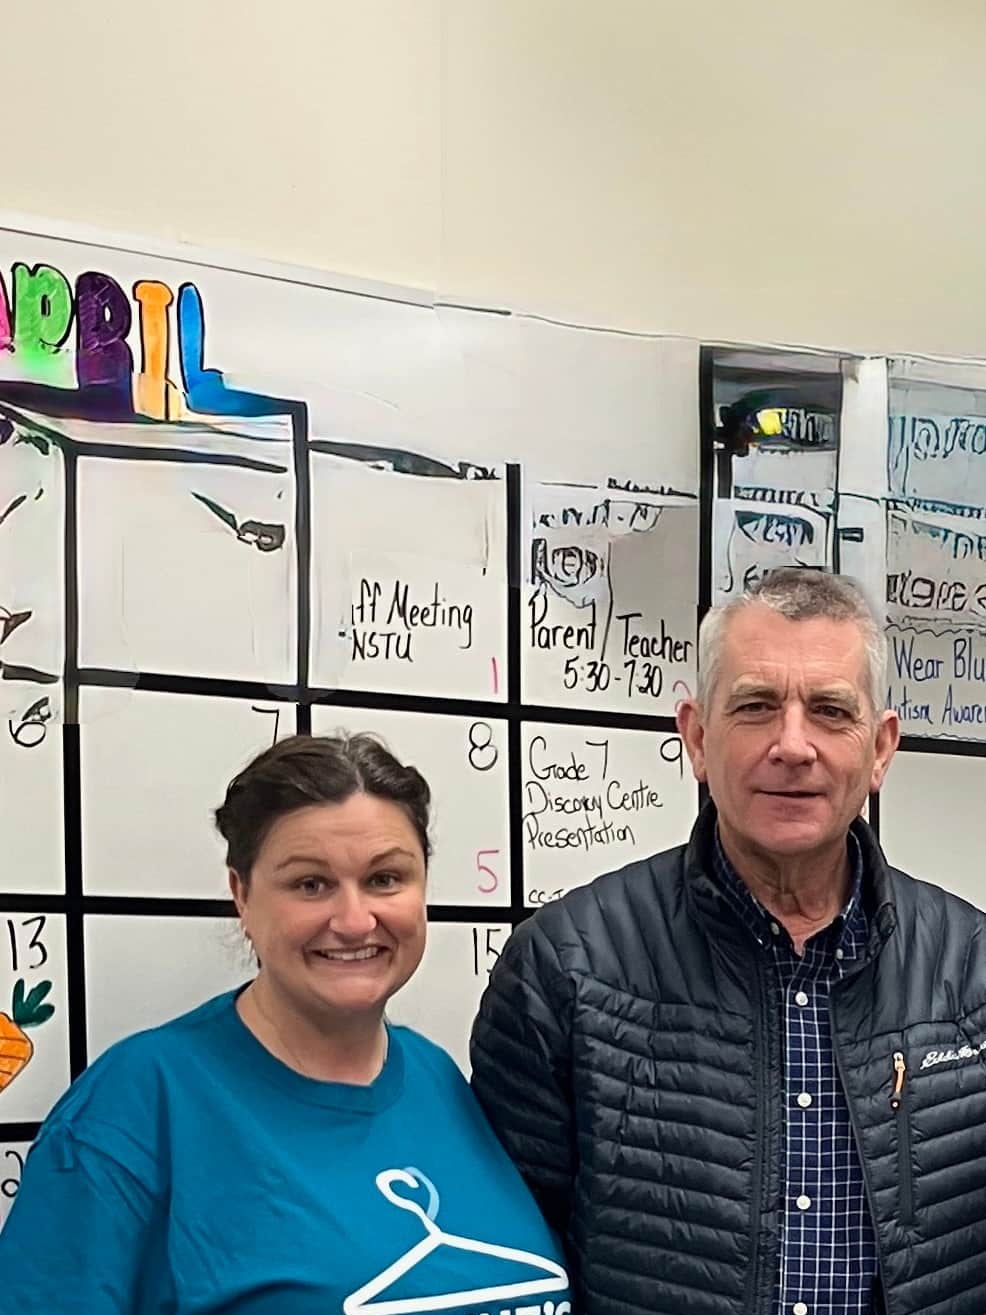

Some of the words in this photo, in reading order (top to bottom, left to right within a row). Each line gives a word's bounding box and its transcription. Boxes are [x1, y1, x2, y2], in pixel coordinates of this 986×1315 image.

[387, 581, 473, 649] Meeting
[352, 628, 414, 663] NSTU
[893, 636, 944, 682] Wear
[491, 656, 499, 694] 1
[252, 705, 280, 748] 7
[469, 721, 498, 771] 8
[529, 736, 590, 780] Grade
[585, 739, 609, 780] 7
[659, 737, 684, 780] 9
[607, 779, 663, 811] Centre
[522, 812, 635, 851] Presentation
[476, 849, 500, 893] 5
[6, 915, 48, 972] 13
[473, 927, 501, 975] 15
